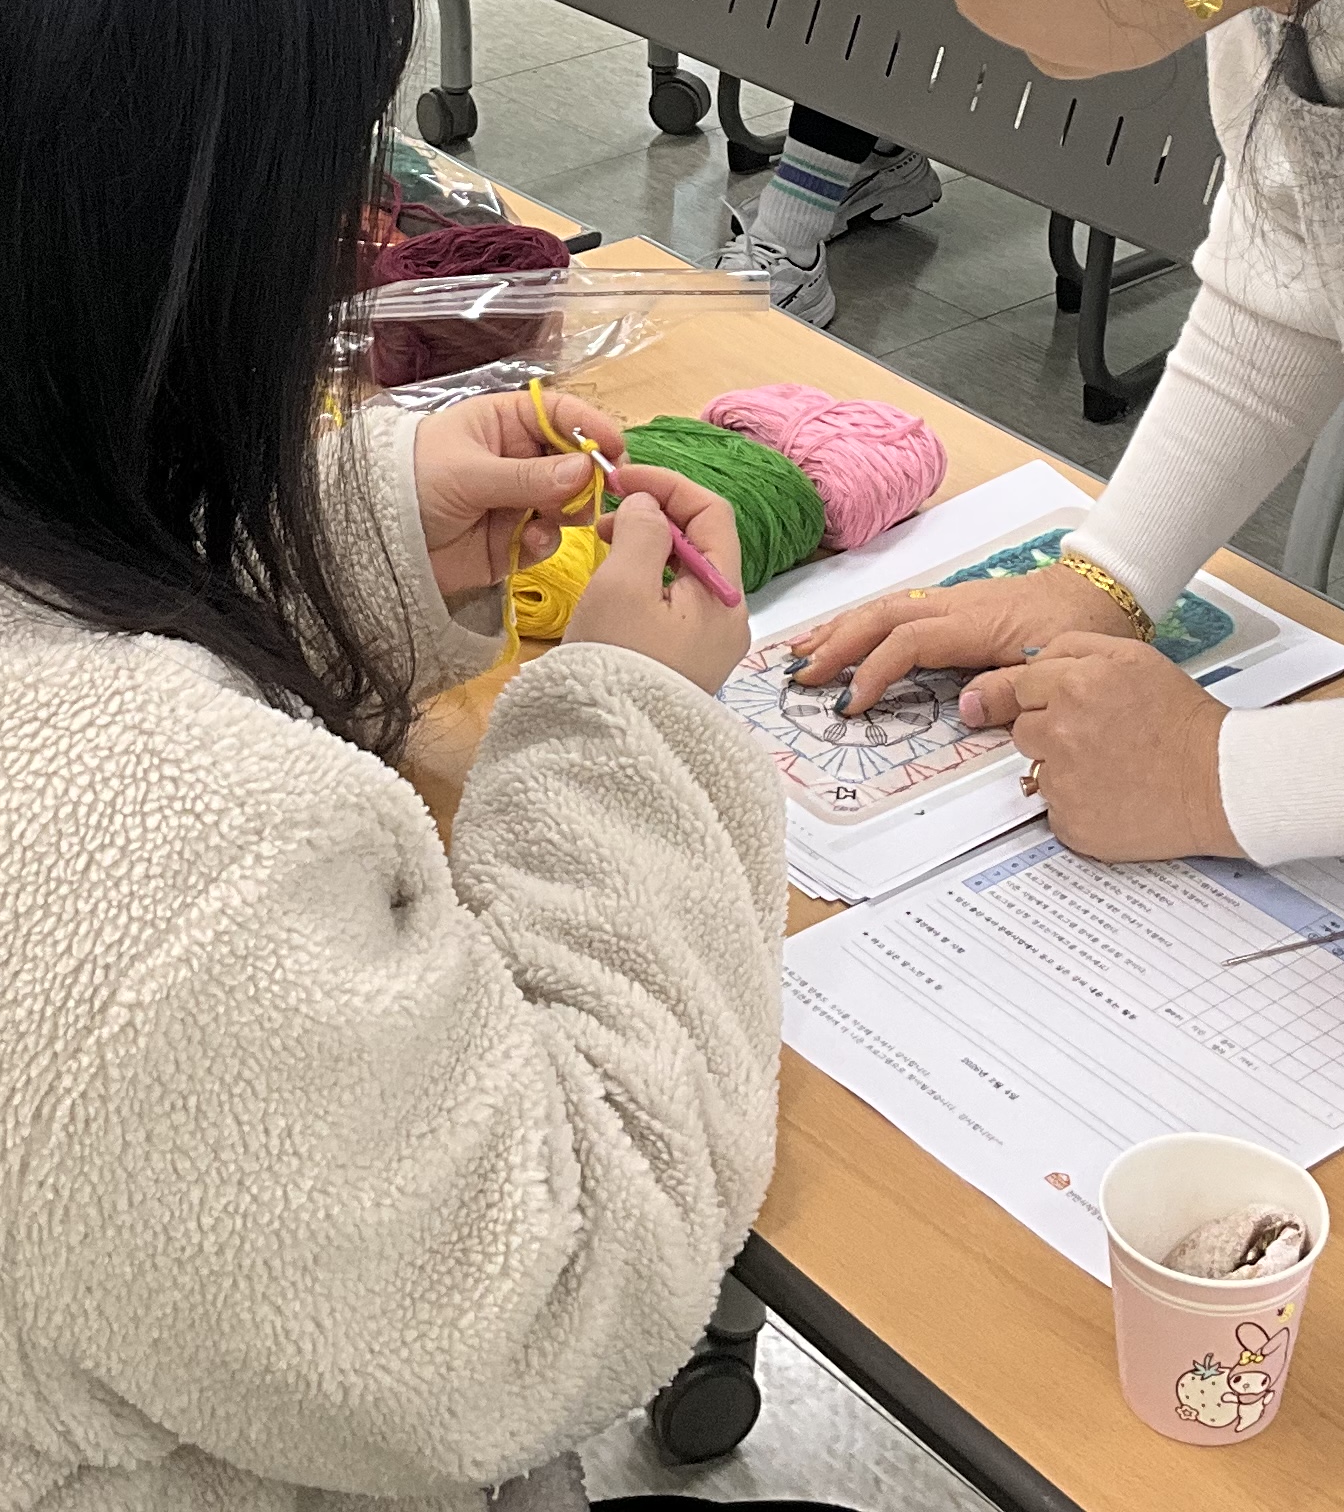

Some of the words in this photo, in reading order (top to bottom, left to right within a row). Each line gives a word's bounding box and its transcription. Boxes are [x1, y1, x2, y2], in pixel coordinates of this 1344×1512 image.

[1024, 872, 1053, 891] 프로그램
[1074, 861, 1103, 882] 프로그램
[987, 890, 1017, 910] 프로그램
[1048, 909, 1079, 929] 프로그램
[807, 986, 829, 1003] 만족도
[1088, 986, 1104, 998] 내용
[864, 1044, 907, 1074] 프로그램으로
[960, 1057, 989, 1078] 2026년
[988, 1077, 1004, 1090] 2월
[1004, 1089, 1020, 1101] 4일
